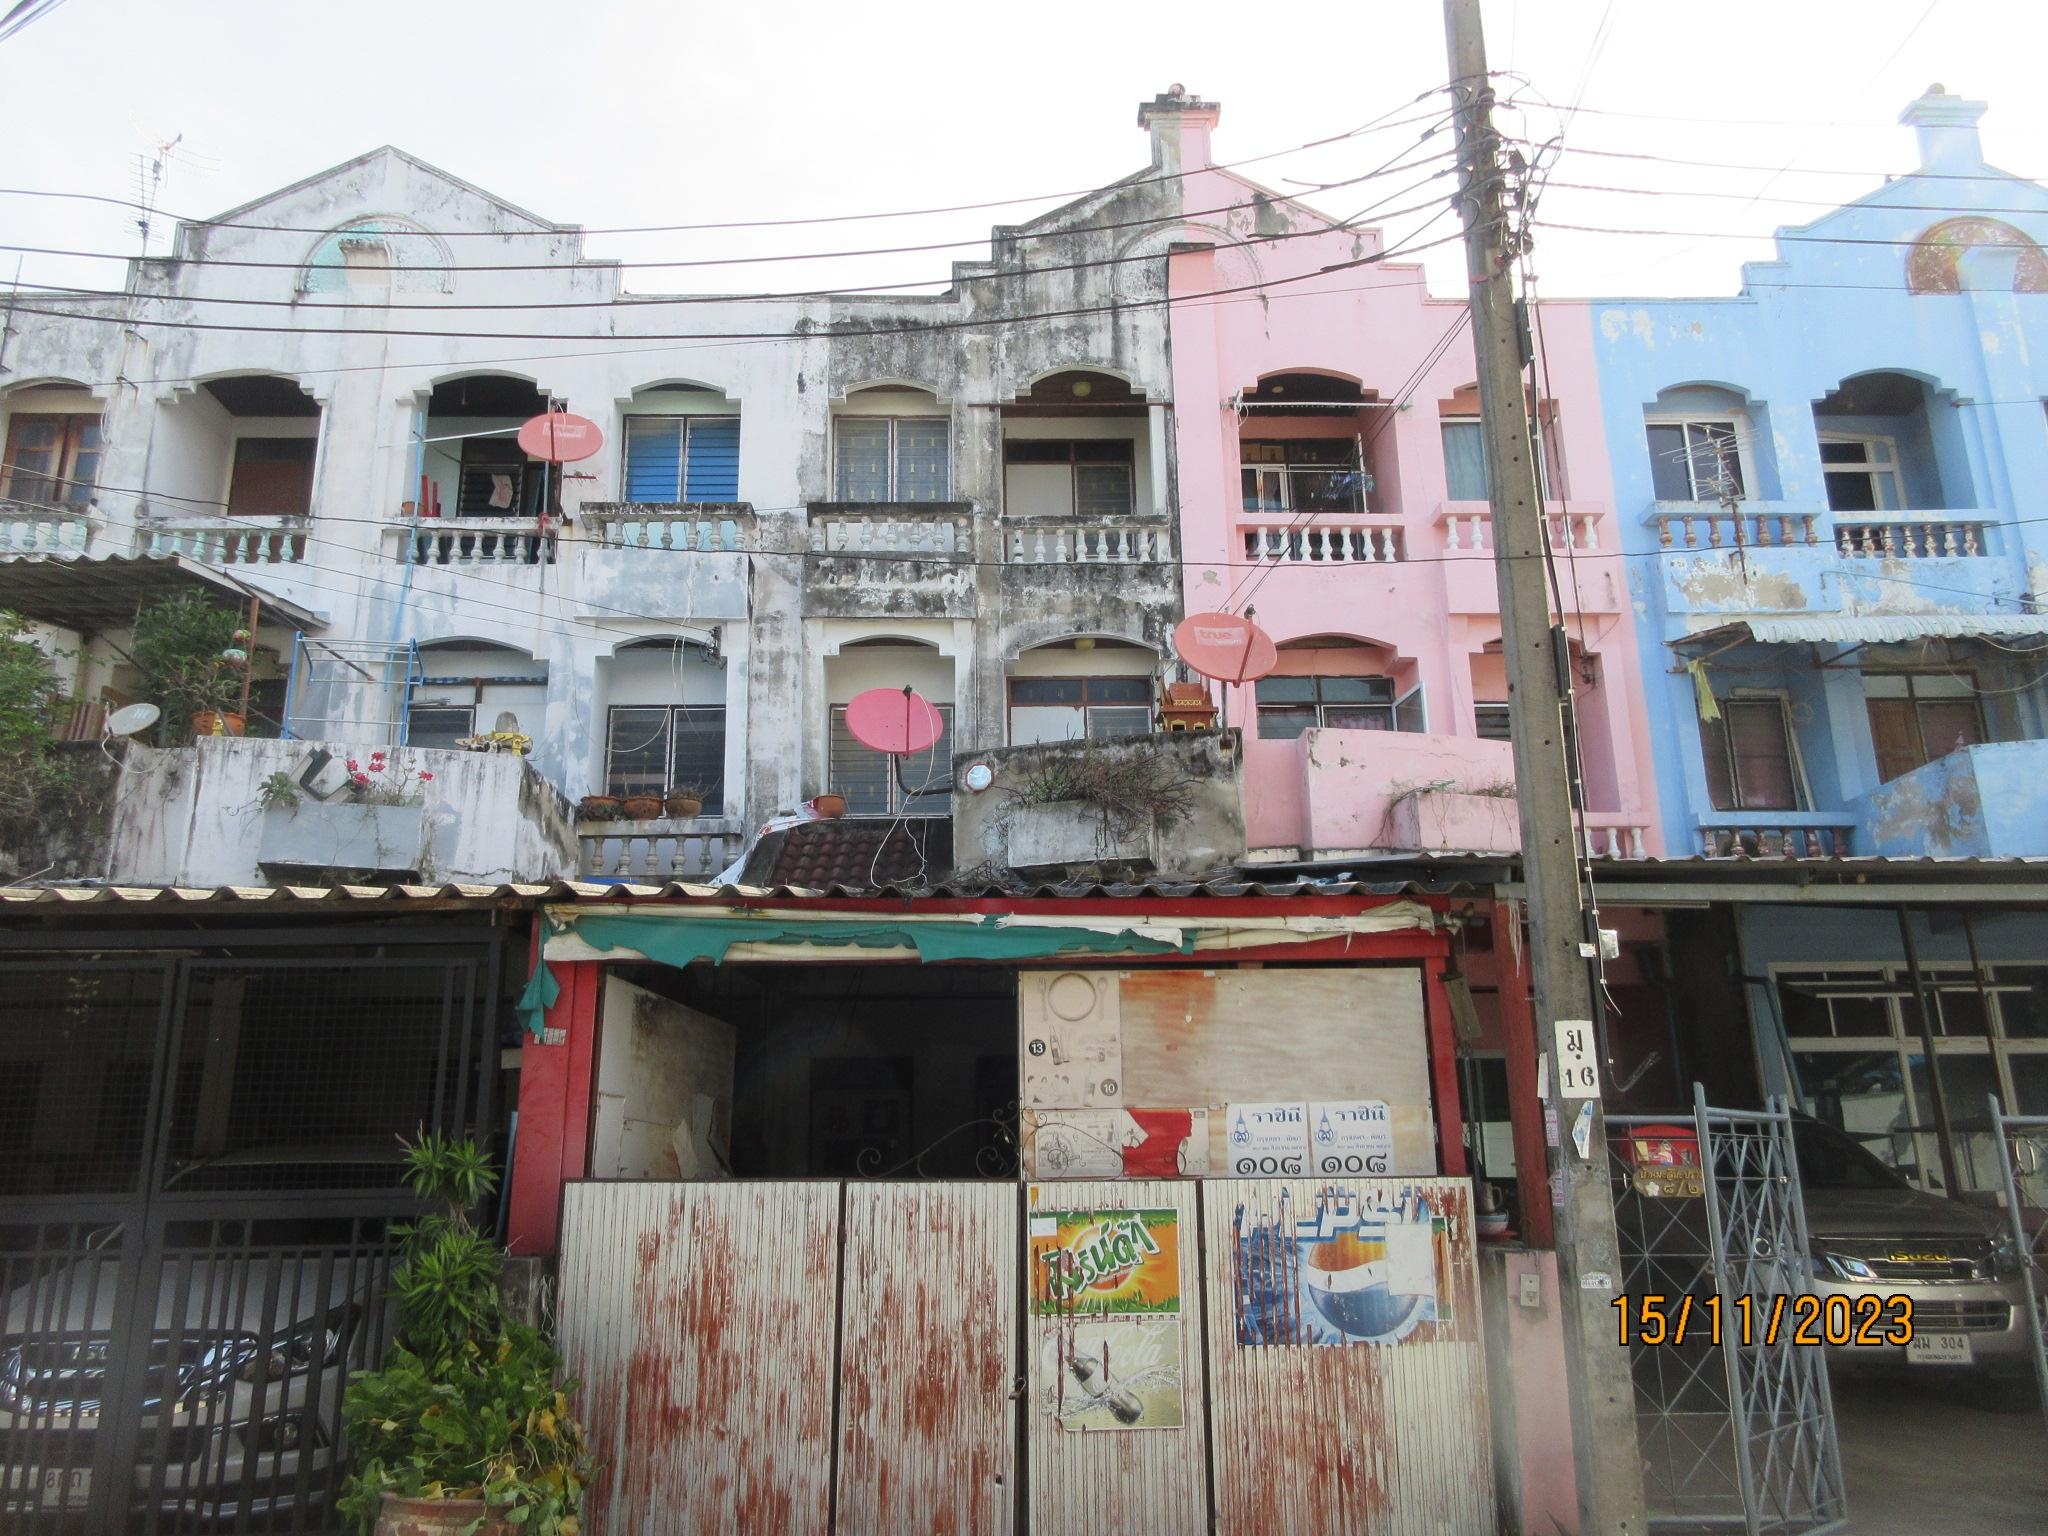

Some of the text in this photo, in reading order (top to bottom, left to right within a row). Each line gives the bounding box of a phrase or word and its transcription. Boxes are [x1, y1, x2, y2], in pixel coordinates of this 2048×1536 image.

[1031, 1044, 1043, 1053] 13
[1565, 1066, 1595, 1087] 16
[1103, 1084, 1115, 1093] 10
[1236, 1153, 1302, 1175] ๑๐๘
[1321, 1152, 1387, 1174] ๑๐๘
[1941, 1336, 1965, 1349] 304
